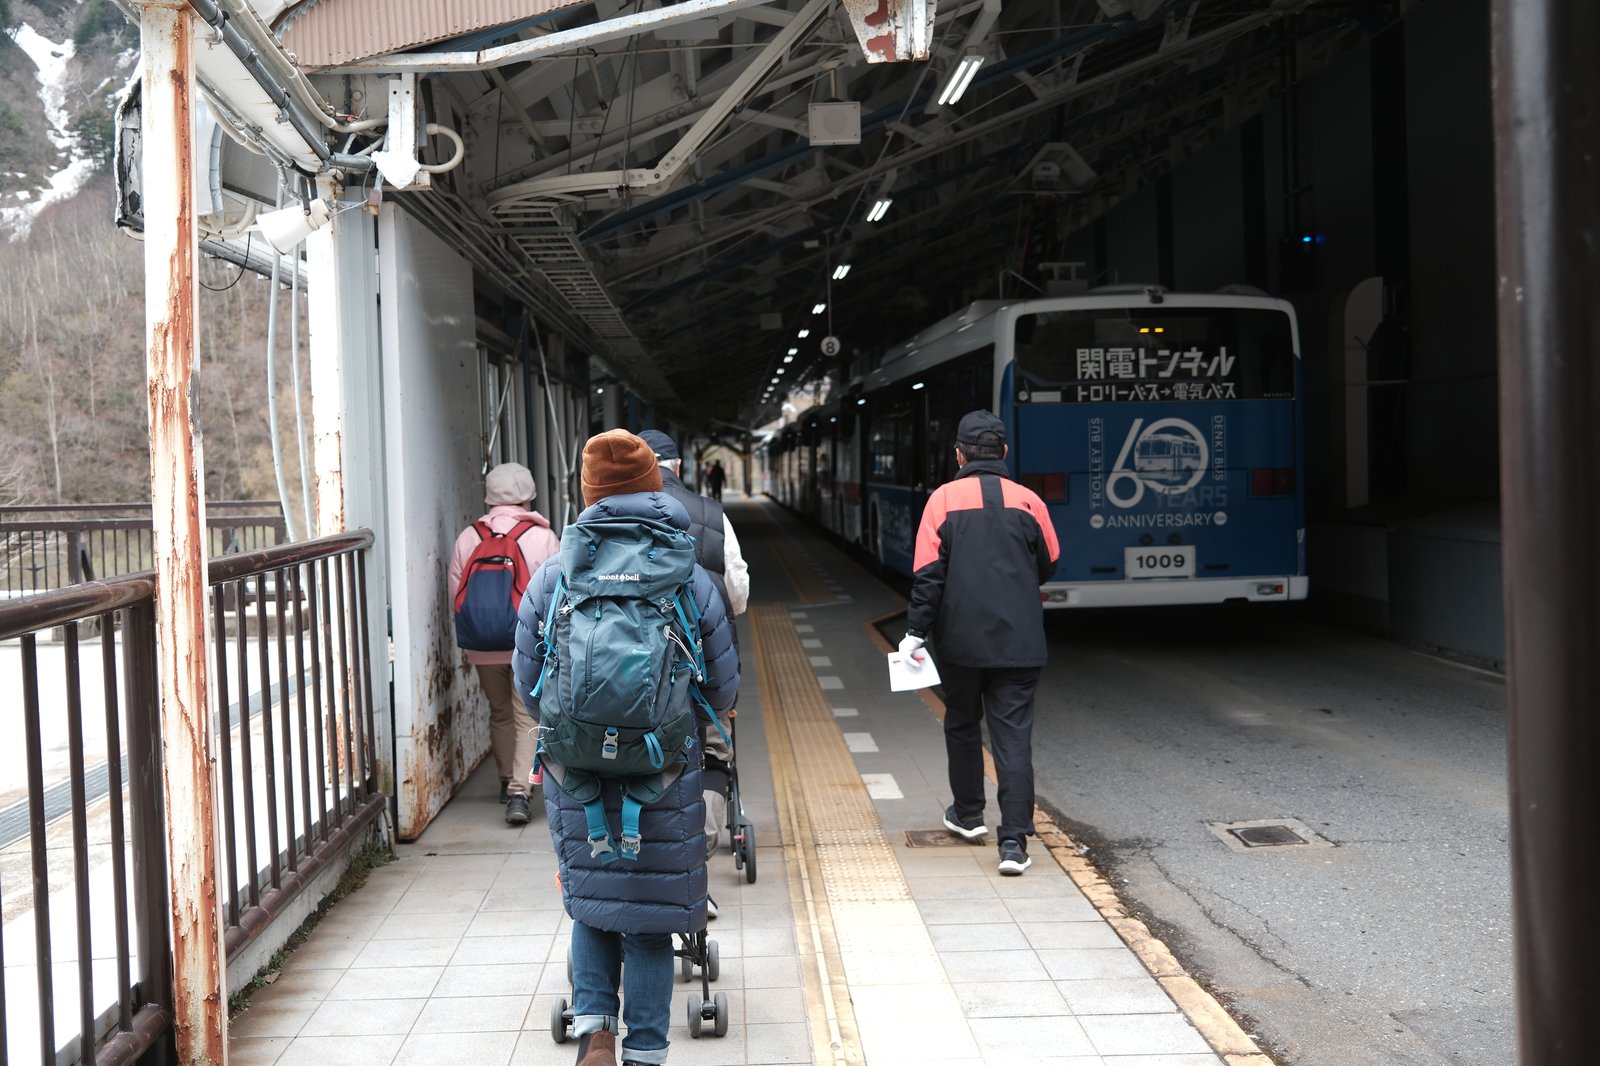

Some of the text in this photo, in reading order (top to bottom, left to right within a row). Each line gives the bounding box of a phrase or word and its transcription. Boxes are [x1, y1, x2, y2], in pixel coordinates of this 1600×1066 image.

[825, 341, 835, 353] 8
[1076, 347, 1236, 379] 関電トンネル
[1091, 417, 1101, 442] BUS
[1214, 415, 1224, 481] DENKI BUS
[1105, 417, 1209, 508] 60
[1091, 449, 1101, 508] TROLLEY
[1154, 486, 1228, 507] YEARS
[1107, 512, 1212, 528] ANNIVERSARY
[1135, 554, 1185, 569] 1009
